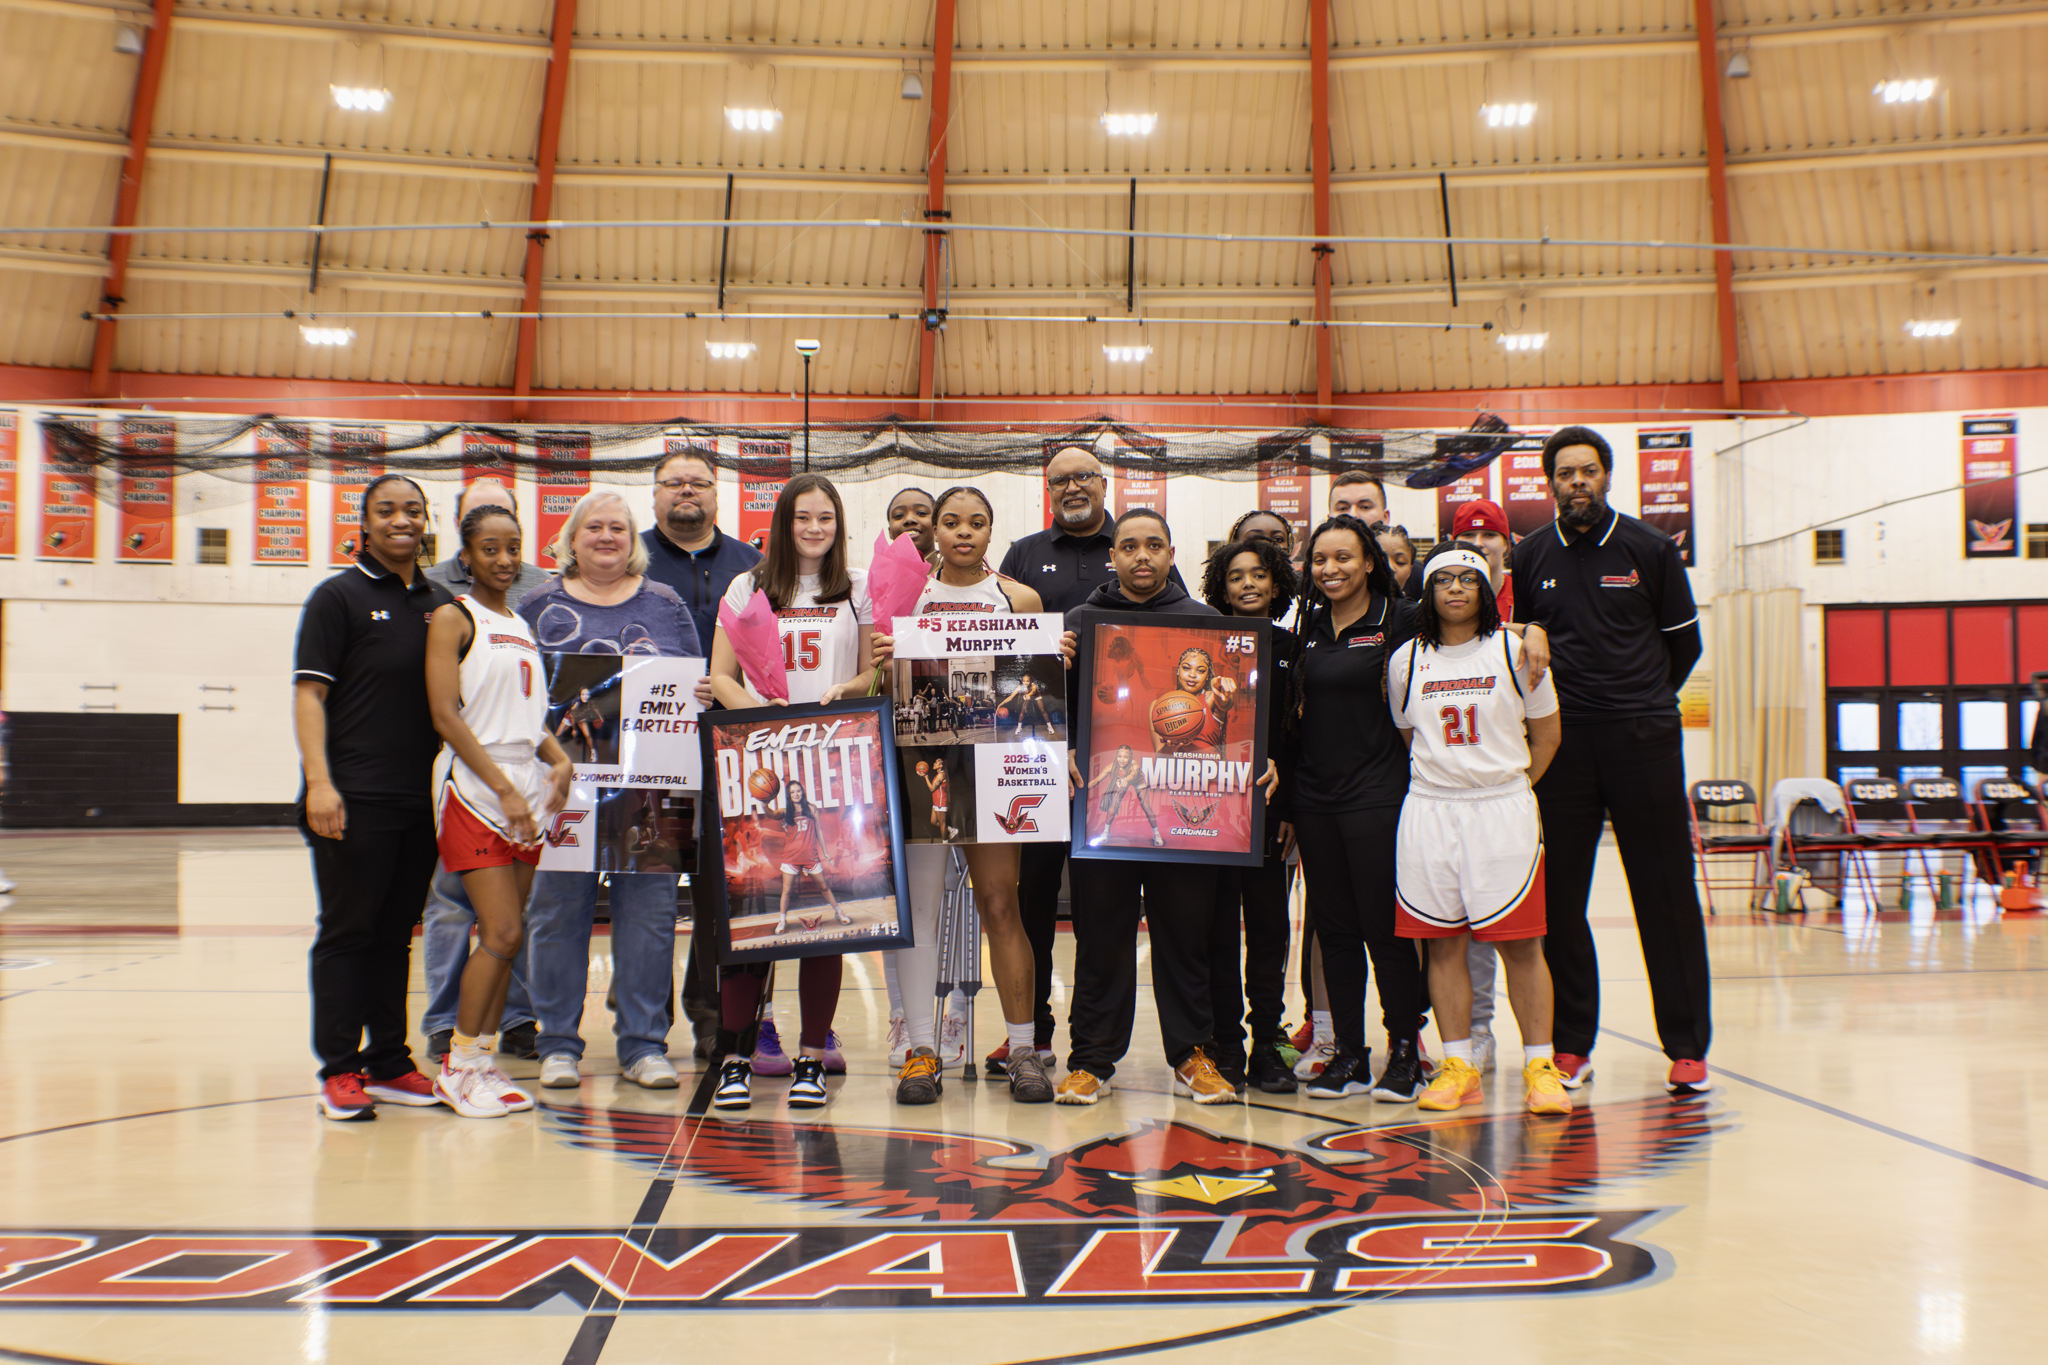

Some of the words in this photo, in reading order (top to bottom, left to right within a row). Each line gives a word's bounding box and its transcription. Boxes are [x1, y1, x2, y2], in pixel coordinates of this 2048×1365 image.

[465, 444, 510, 454] SOFBALL
[668, 441, 713, 451] SOFBALL
[1513, 456, 1542, 468] 2018
[330, 475, 375, 484] TOURNAME
[537, 476, 588, 486] TOURNAMENT
[50, 482, 80, 491] REGION
[265, 487, 294, 496] REGION
[744, 482, 784, 491] MARYLAND
[123, 492, 166, 502] CHAMPION
[342, 493, 363, 501] REGI
[543, 496, 571, 504] REGION
[755, 492, 774, 501] JUCO
[274, 498, 285, 506] XX
[744, 501, 776, 511] CHAMPI
[43, 505, 87, 515] CHAMPION
[258, 509, 301, 518] CHAMPION
[542, 505, 572, 513] CHAMPI
[335, 514, 361, 523] CHAM
[258, 526, 301, 535] MARYLAND
[269, 537, 289, 546] JUCO
[258, 548, 301, 557] CHAMPION
[922, 602, 997, 614] CARDINALS
[917, 617, 942, 632] #5
[947, 618, 1039, 632] KEASHIANA
[488, 633, 538, 652] CARDINAL
[946, 637, 1016, 652] MURPHY
[1225, 635, 1255, 654] #5
[780, 630, 821, 672] 15
[1421, 676, 1497, 695] CARDINALS
[649, 684, 677, 698] #15
[1421, 693, 1438, 701] CCBC
[1441, 690, 1492, 698] CATONSVILLE
[639, 701, 686, 716] EMILY
[1156, 701, 1191, 717] SPALDING
[622, 718, 698, 734] BARTLETT
[1440, 704, 1482, 747] 21
[746, 719, 842, 751] EMILY
[1003, 754, 1047, 764] 2025-26
[1173, 752, 1221, 760] KEASHAIANA
[1003, 766, 1048, 775] WOMEN'S
[1142, 757, 1251, 794] MURPHY
[581, 773, 625, 783] WOMEN'S
[628, 774, 688, 785] BASKETBALL
[717, 736, 873, 818] BARTLETT
[997, 778, 1057, 787] BASKETBALL
[1697, 785, 1745, 801] CCBC
[1854, 784, 1898, 800] CCBC
[1911, 783, 1957, 798] CCBC
[1170, 827, 1220, 837] CARDINALS
[870, 921, 900, 937] #15
[782, 936, 807, 944] CLASS
